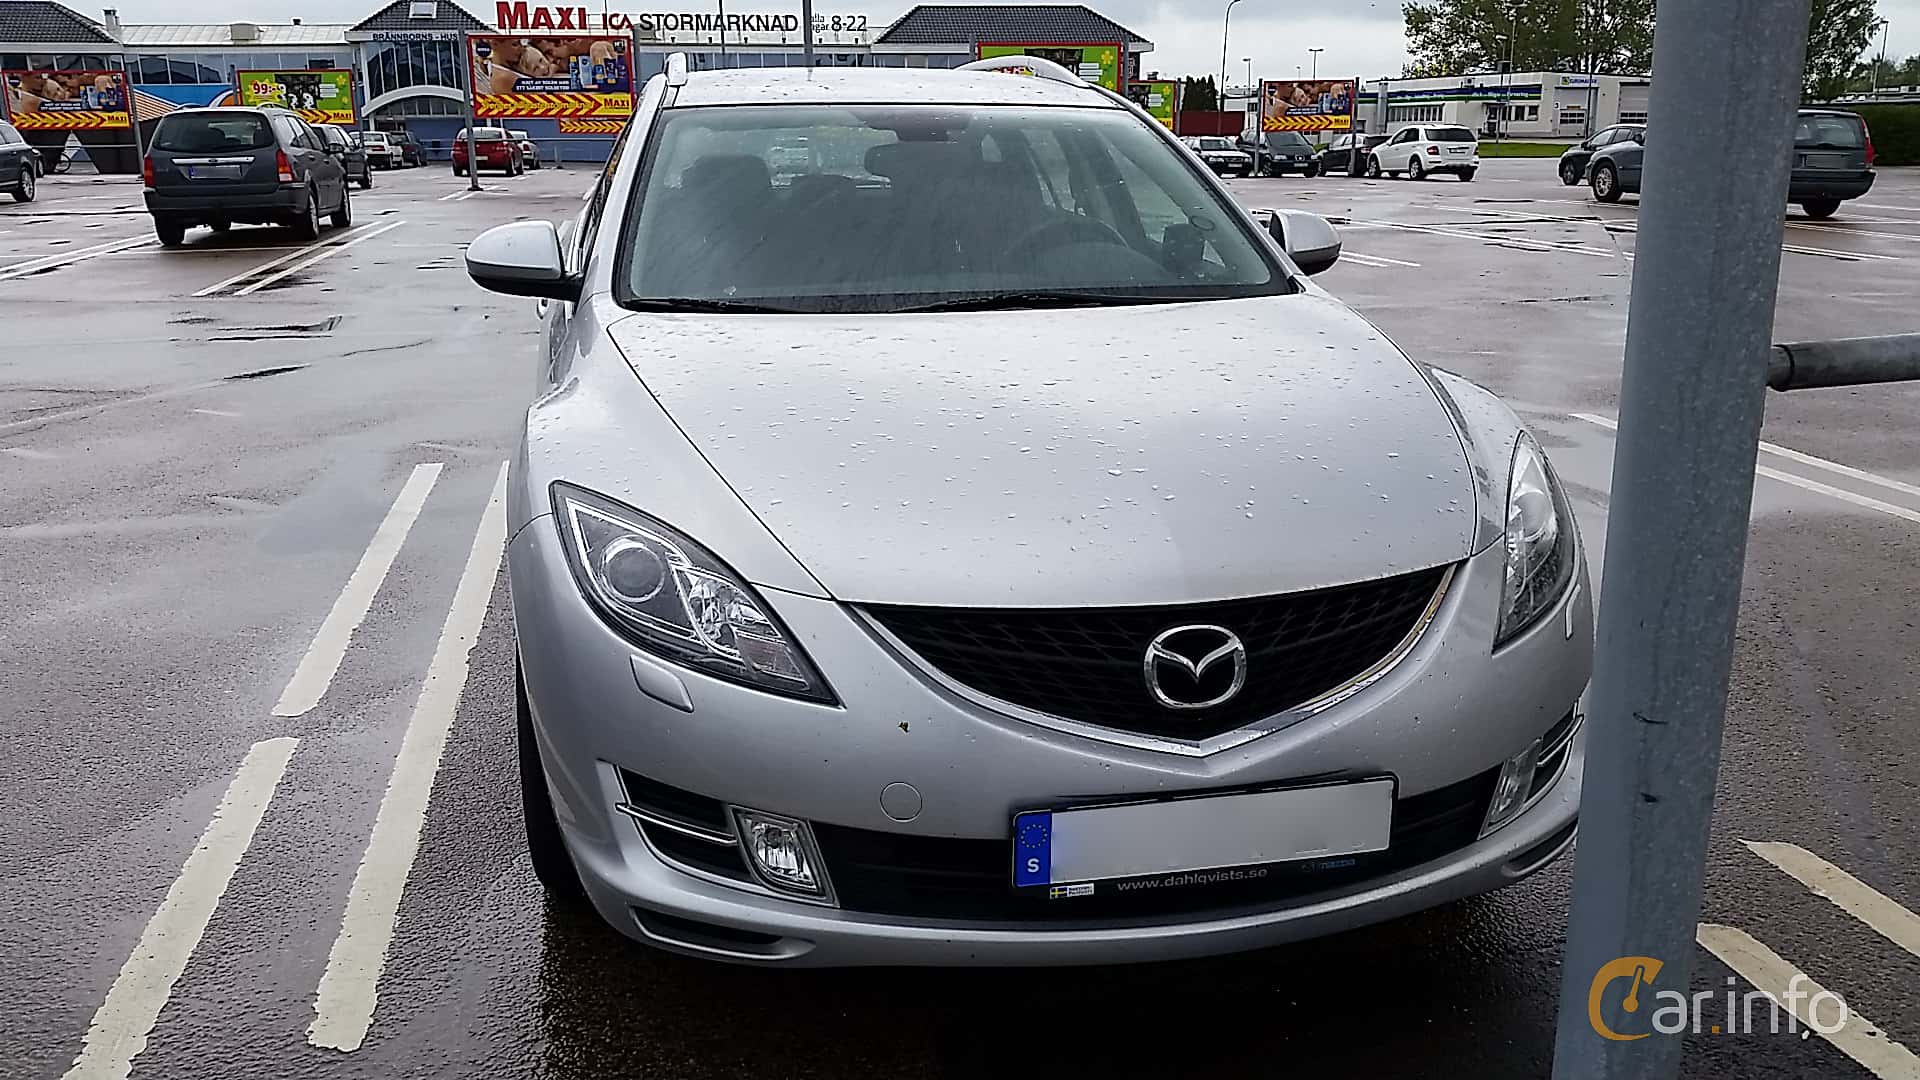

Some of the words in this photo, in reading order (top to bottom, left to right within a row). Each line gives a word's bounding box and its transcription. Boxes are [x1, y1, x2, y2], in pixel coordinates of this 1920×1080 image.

[496, 1, 587, 30] MAXI
[602, 13, 634, 30] ICA
[639, 13, 798, 31] STORMARKNAD
[831, 15, 867, 32] 8-22
[441, 33, 458, 41] HUS
[604, 99, 629, 109] MAXI
[1026, 858, 1040, 874] S
[1117, 868, 1268, 891] www.dahlqvists.se
